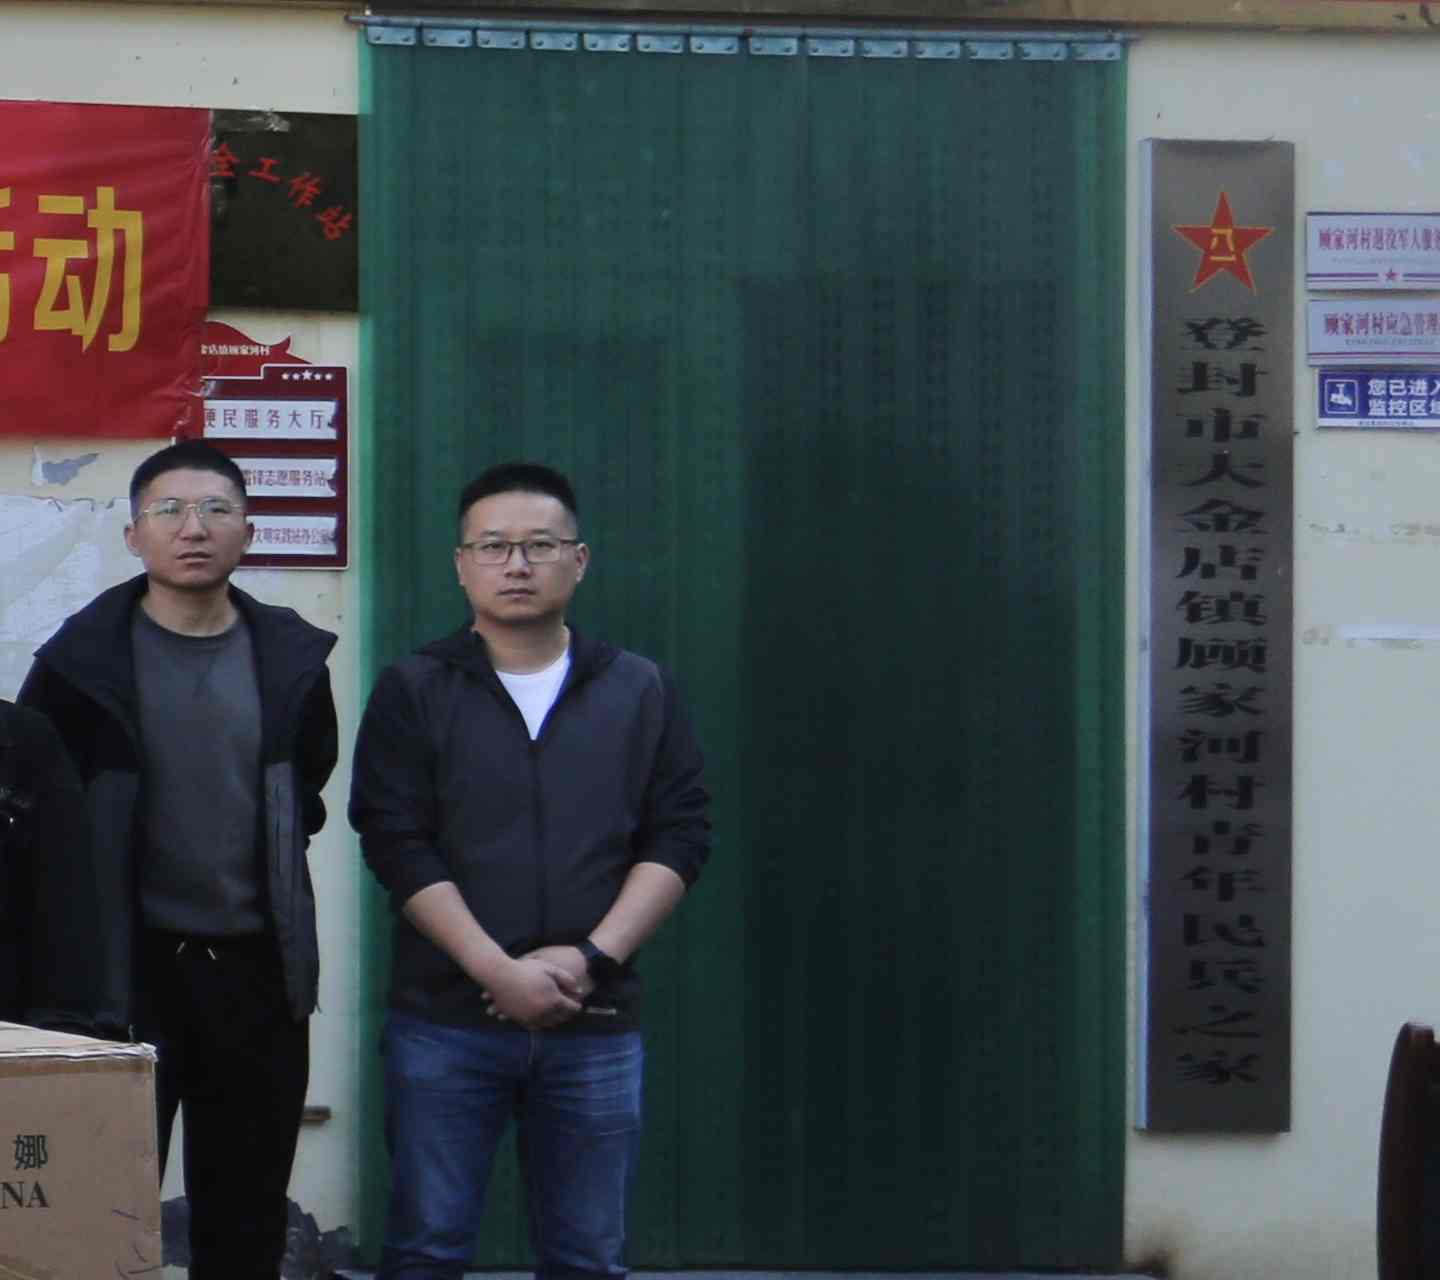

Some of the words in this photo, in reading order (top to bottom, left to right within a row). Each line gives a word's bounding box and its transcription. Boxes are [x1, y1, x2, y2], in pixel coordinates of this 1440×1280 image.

[1324, 312, 1440, 336] 顾家河村应急管理
